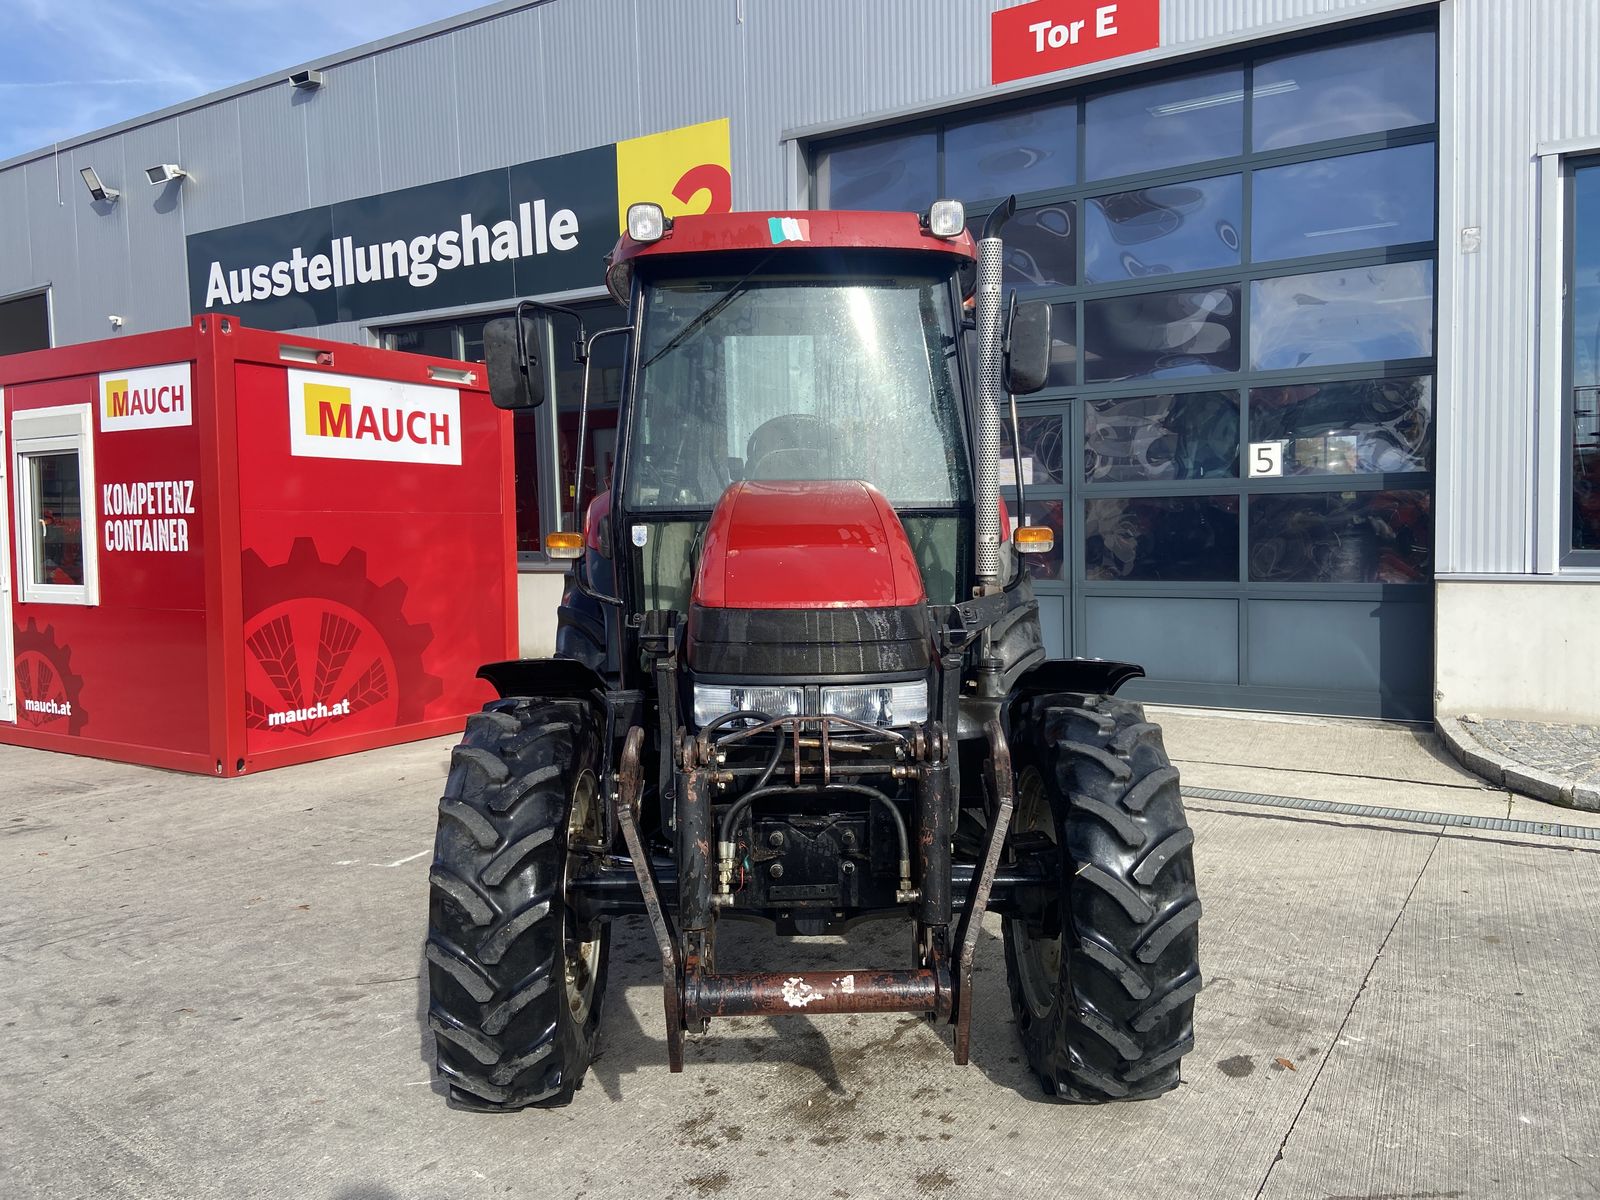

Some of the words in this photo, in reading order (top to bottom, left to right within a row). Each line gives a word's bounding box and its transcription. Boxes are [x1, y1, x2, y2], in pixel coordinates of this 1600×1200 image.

[1028, 20, 1085, 53] Tor
[1096, 4, 1118, 38] E
[205, 199, 579, 308] Ausstellungshalle
[112, 385, 185, 417] MAUCH
[318, 401, 450, 446] MAUCH
[1256, 447, 1274, 473] 5
[103, 479, 195, 516] KOMPETENZ
[104, 518, 189, 552] CONTAINER
[25, 698, 72, 717] mauch.at
[268, 698, 351, 726] mauch.at
